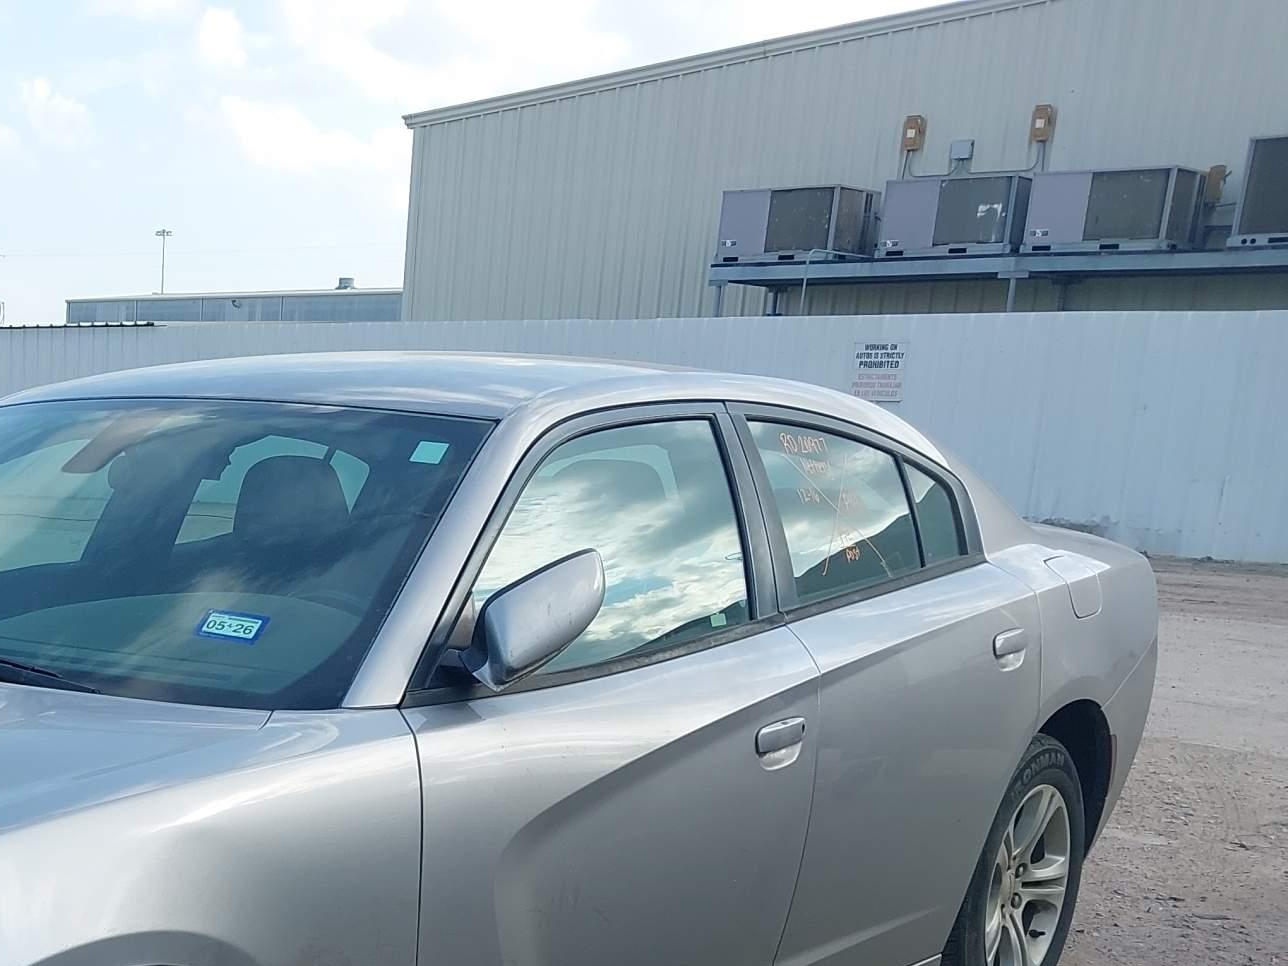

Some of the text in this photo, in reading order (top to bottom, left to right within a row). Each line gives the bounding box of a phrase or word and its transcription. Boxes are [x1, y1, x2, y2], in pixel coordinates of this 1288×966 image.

[856, 352, 905, 360] AUTOS IS STRICTLY
[859, 360, 900, 369] PROHIBITED
